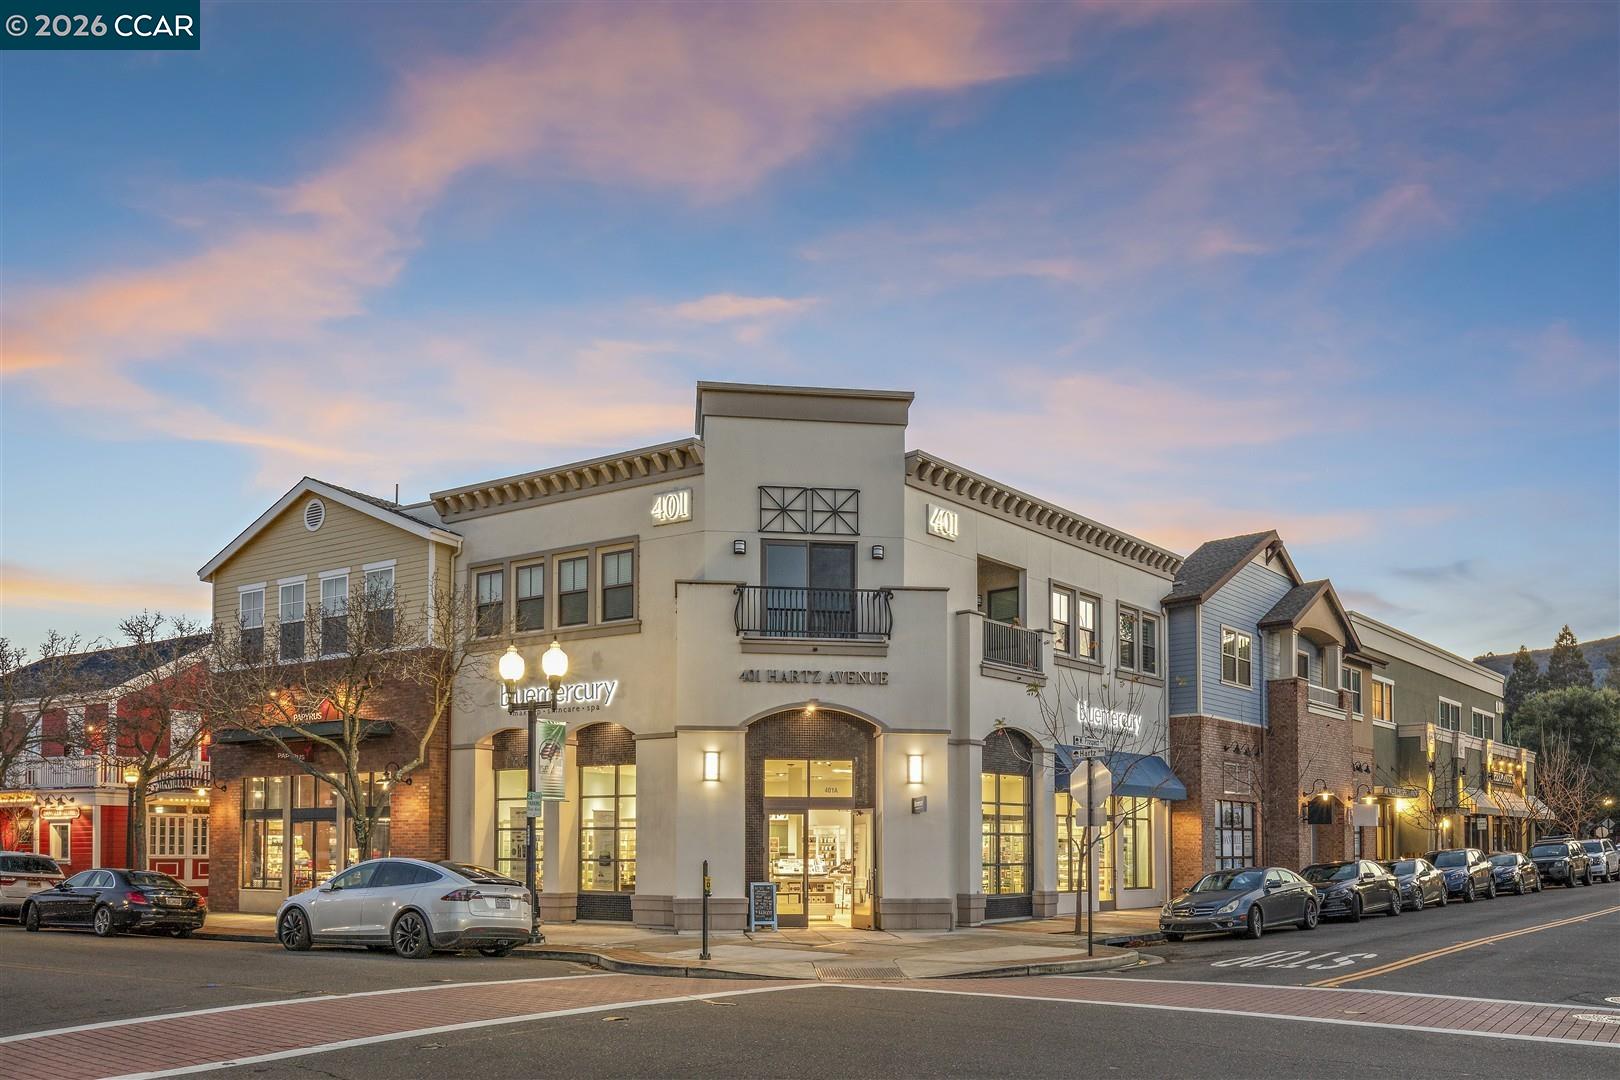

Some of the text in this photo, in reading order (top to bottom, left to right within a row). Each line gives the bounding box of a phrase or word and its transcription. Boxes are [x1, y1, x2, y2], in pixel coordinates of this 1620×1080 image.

[651, 492, 688, 521] 401
[930, 507, 958, 537] 401
[739, 669, 889, 685] 401 HARTZ AVENUE
[500, 680, 618, 708] buemercury
[547, 705, 580, 714] sincare
[587, 704, 600, 713] spa
[293, 711, 323, 722] PAPYRUS
[277, 752, 305, 761] PAPUS
[1080, 749, 1097, 757] Hartz
[824, 786, 839, 794] 401A
